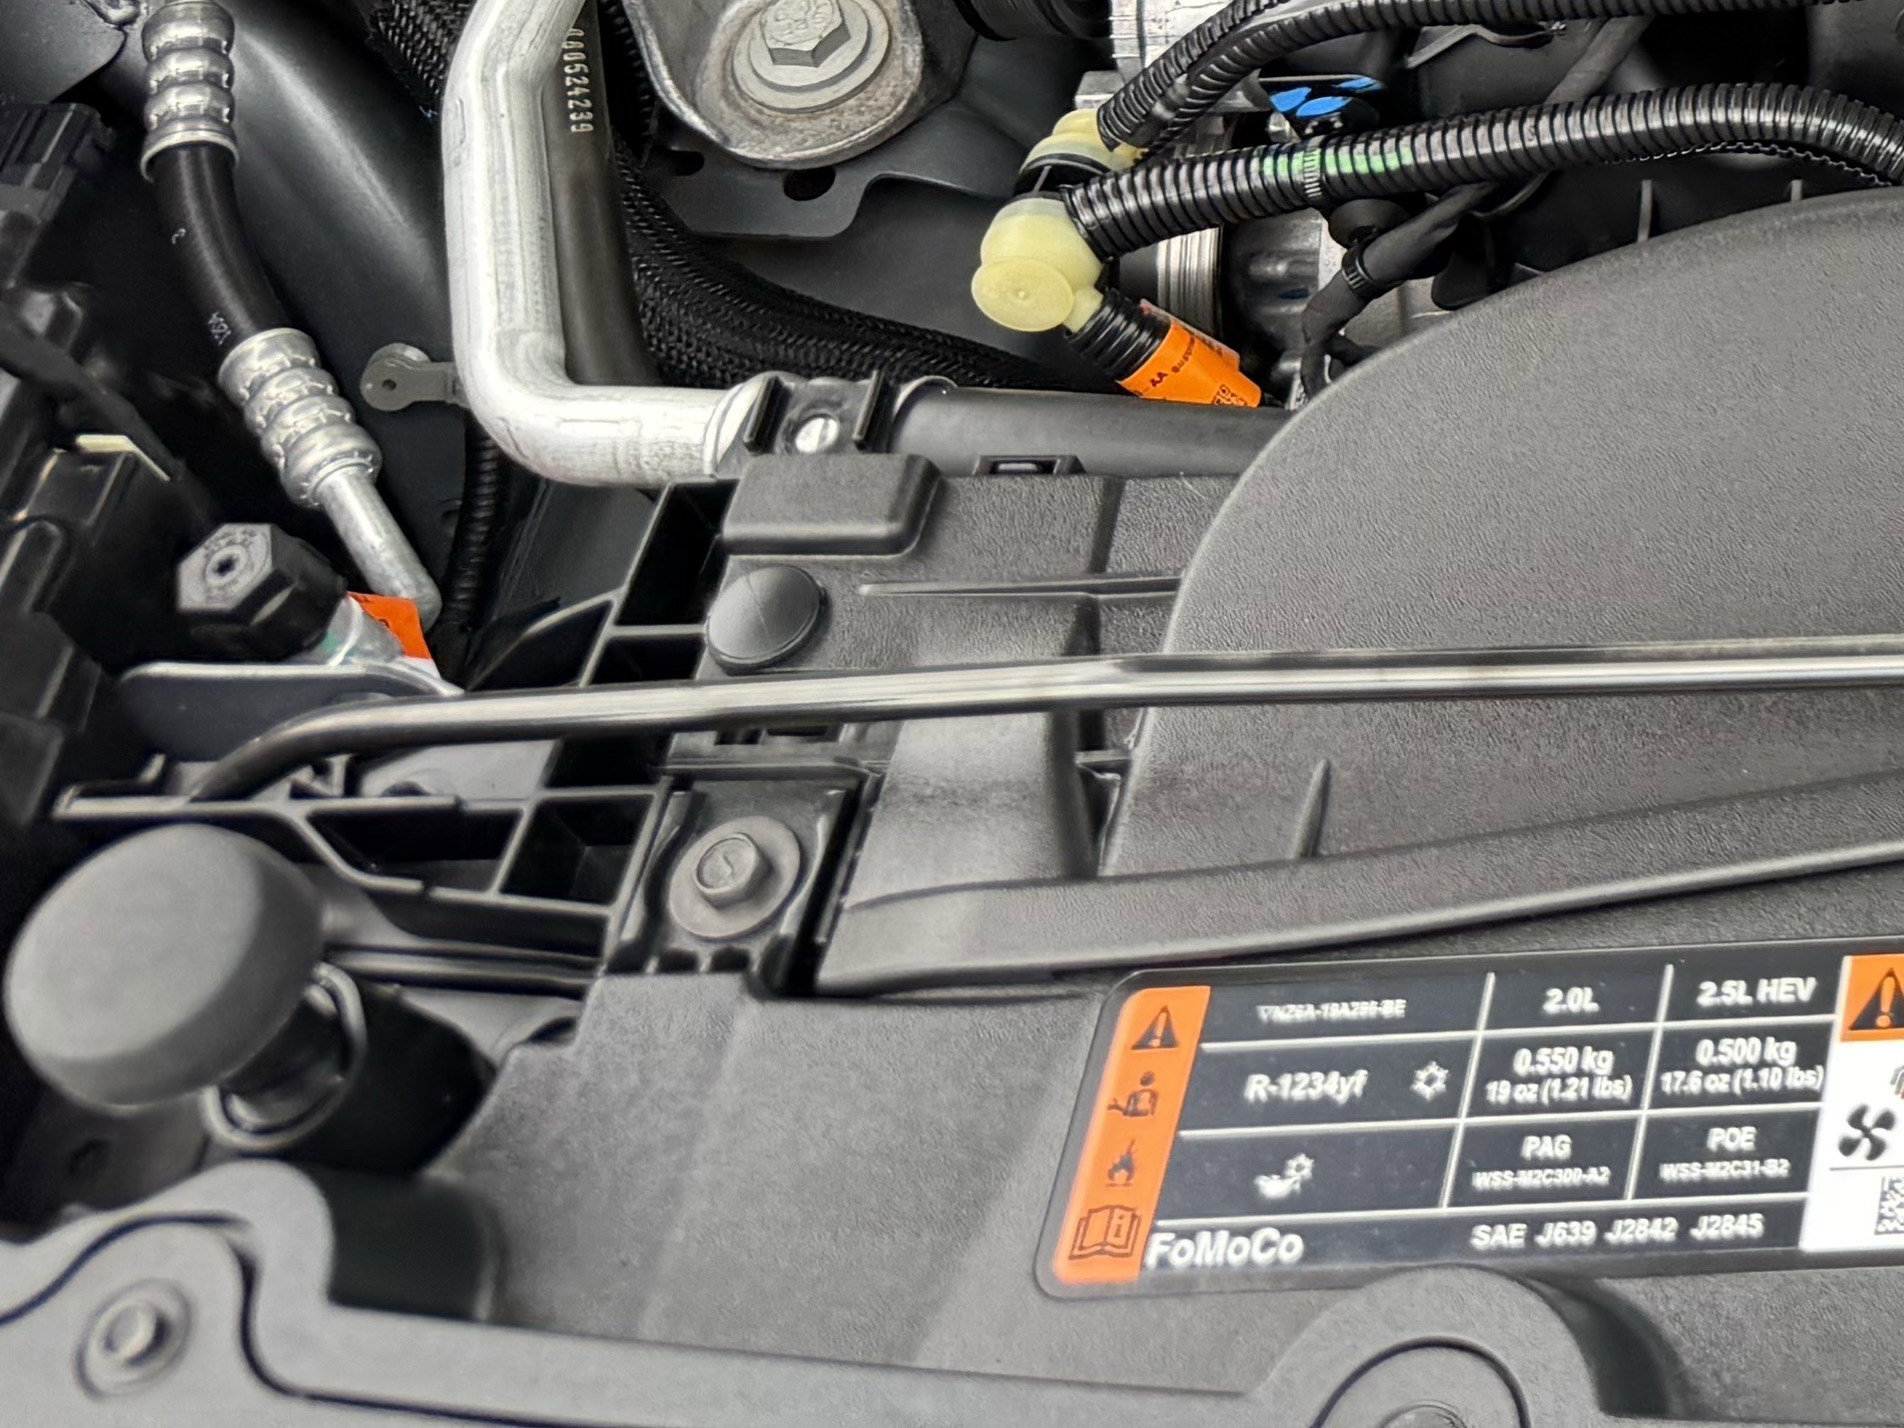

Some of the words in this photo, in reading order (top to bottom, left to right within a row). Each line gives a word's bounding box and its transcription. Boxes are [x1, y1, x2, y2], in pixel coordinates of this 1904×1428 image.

[1543, 987, 1600, 1015] 2.0L
[1695, 979, 1752, 1007] 2.5L
[1756, 976, 1818, 1004] HEV
[1512, 1047, 1580, 1078] 0.550
[1580, 1046, 1616, 1076] kg
[1695, 1037, 1760, 1067] 0.500
[1762, 1036, 1798, 1067] kg
[1244, 1068, 1369, 1107] R-1234yf
[1485, 1079, 1511, 1105] 19
[1512, 1081, 1540, 1103] oz
[1541, 1076, 1590, 1106] (1.21
[1591, 1074, 1634, 1102] lbs)
[1659, 1070, 1703, 1095] 17.6
[1704, 1070, 1731, 1094] oz
[1732, 1067, 1783, 1096] (1.10
[1785, 1065, 1826, 1092] lbs)
[1521, 1133, 1573, 1162] PAG
[1706, 1126, 1758, 1154] POE
[1471, 1166, 1612, 1190] WSS-M2C300-A2
[1470, 1222, 1528, 1249] SAE
[1534, 1220, 1598, 1246] J639
[1604, 1216, 1679, 1243] J2842
[1689, 1212, 1765, 1241] J2845
[1145, 1226, 1305, 1269] FoMoCo
